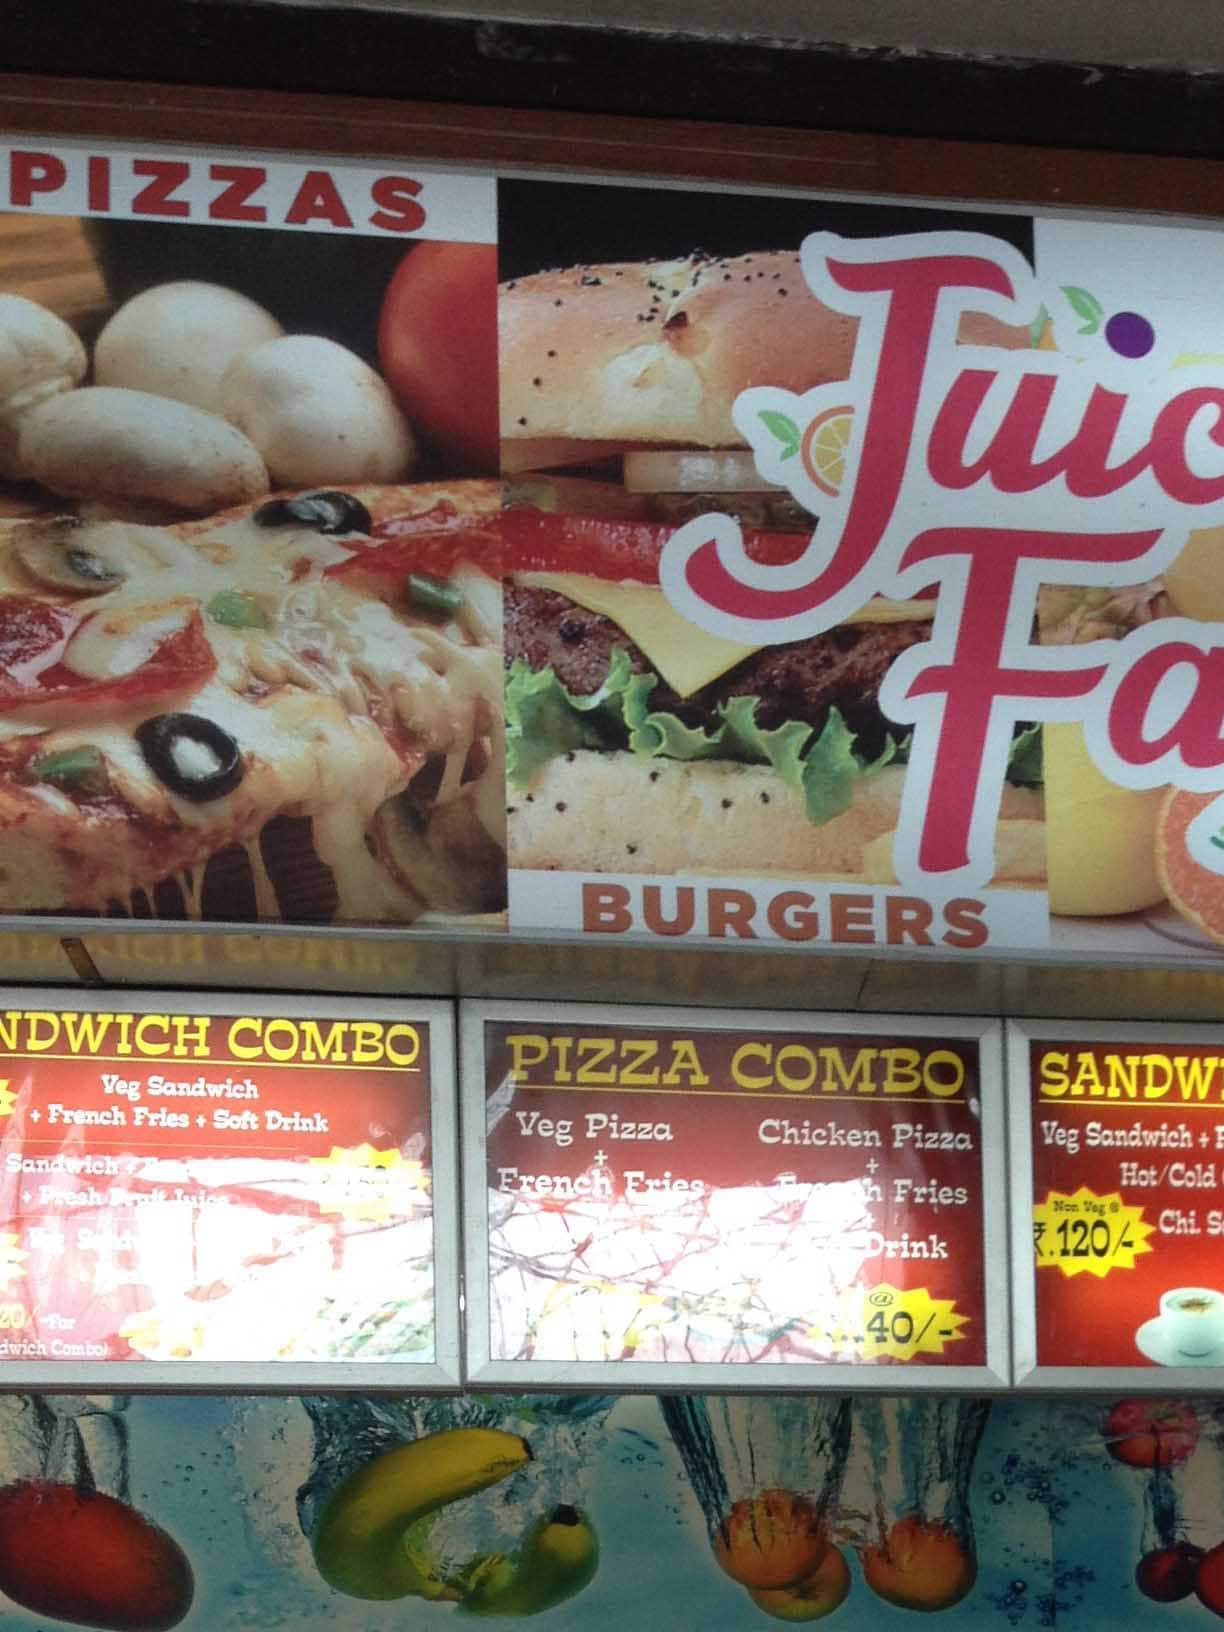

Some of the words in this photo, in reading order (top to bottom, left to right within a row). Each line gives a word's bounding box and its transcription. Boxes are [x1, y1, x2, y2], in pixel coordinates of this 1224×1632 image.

[9, 150, 427, 233] PIZZAS
[581, 882, 989, 949] BURGERS
[228, 1018, 421, 1065] COMBO
[506, 1034, 709, 1086] PIZZA
[731, 1041, 965, 1096] COMBO
[101, 1075, 141, 1101] Veg
[147, 1075, 259, 1100] Sandwich
[48, 1104, 126, 1126] French
[133, 1106, 189, 1128] Fries
[213, 1109, 259, 1131] Soft
[265, 1111, 329, 1134] Drink
[515, 1112, 573, 1146] Veg
[585, 1113, 674, 1142] Pizza
[758, 1119, 882, 1148] Chicken
[892, 1123, 974, 1152] Pizza
[1040, 1121, 1080, 1154] Veg
[1085, 1121, 1193, 1149] Sandwich
[497, 1168, 614, 1197] French
[624, 1171, 705, 1197] Fries
[893, 1179, 968, 1205] Fries
[1119, 1162, 1217, 1189] Hot/Cold
[865, 1233, 948, 1259] Drink
